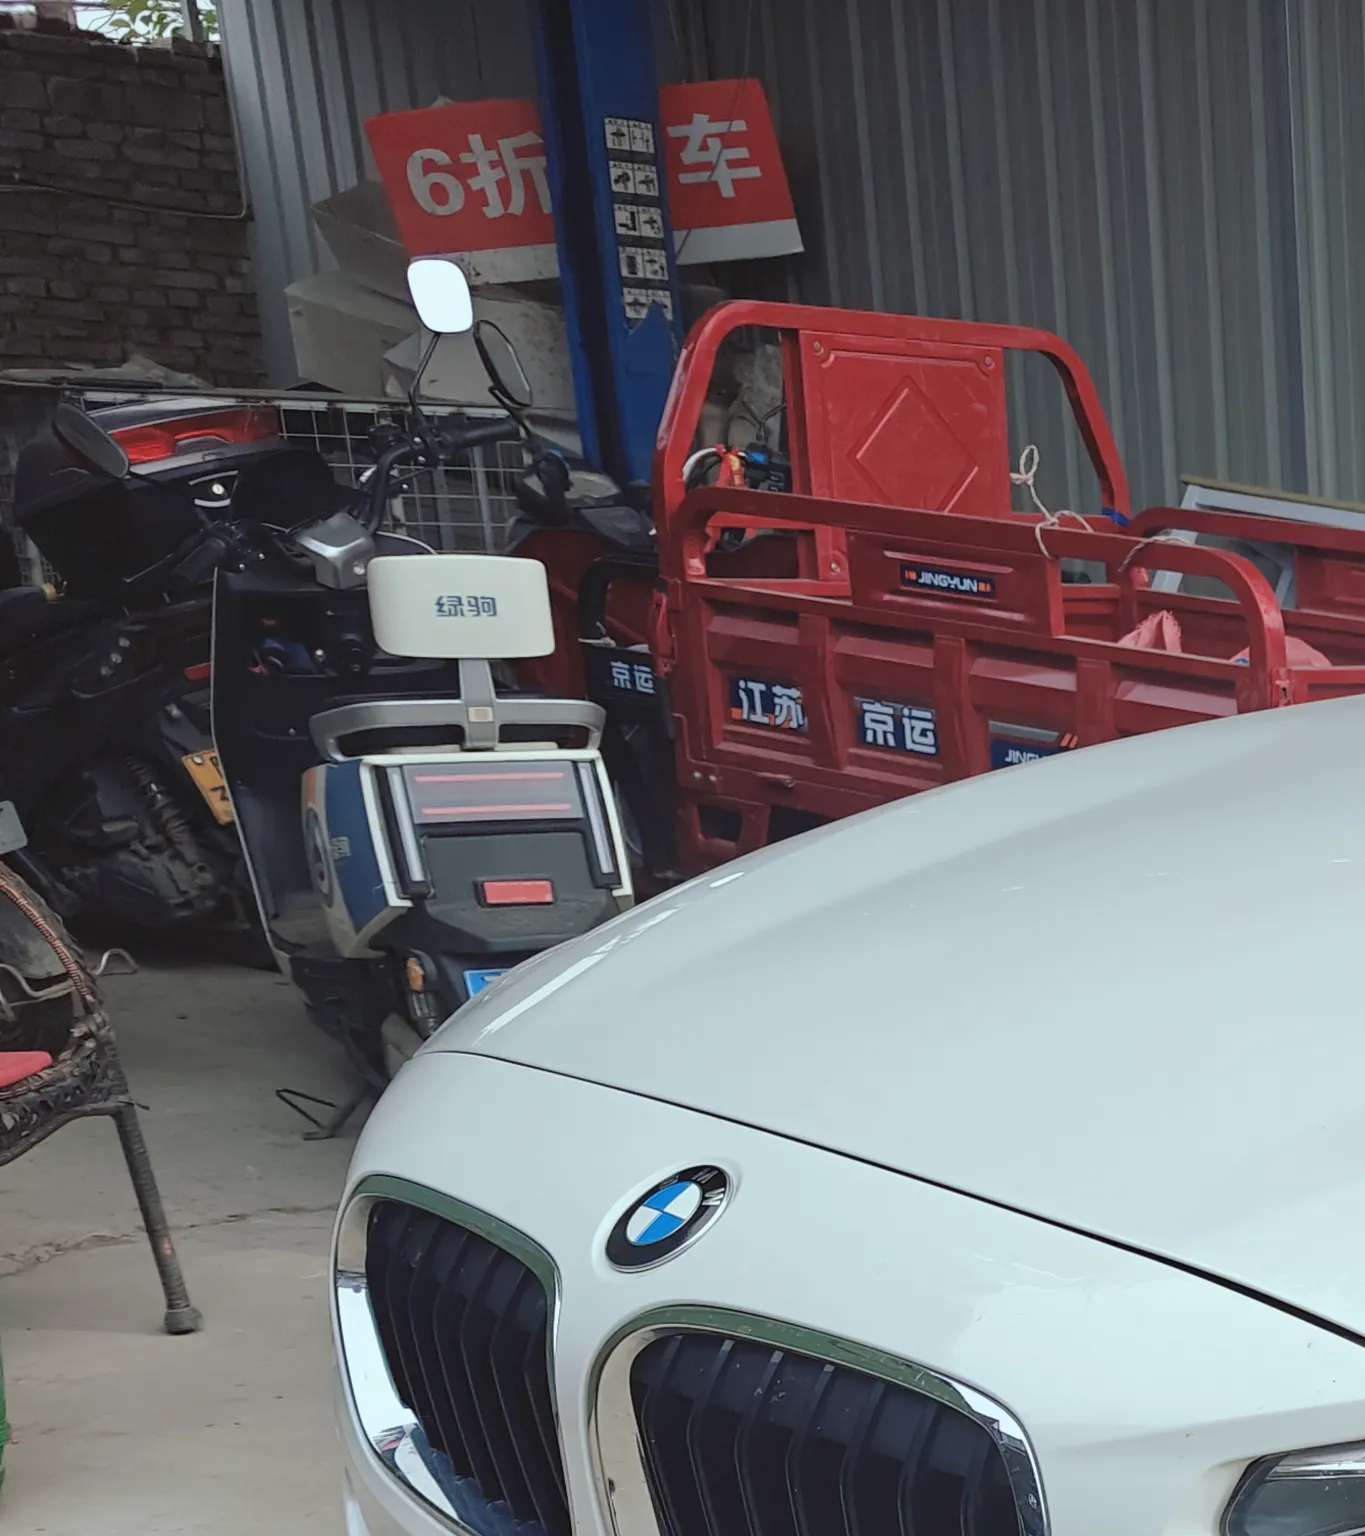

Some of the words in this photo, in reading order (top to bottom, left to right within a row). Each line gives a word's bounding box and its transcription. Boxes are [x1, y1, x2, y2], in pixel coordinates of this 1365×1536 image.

[666, 113, 761, 198] 车
[918, 571, 978, 593] JINGYUN
[435, 595, 498, 617] 绿驹
[610, 661, 656, 694] 京运
[738, 679, 808, 729] 江苏
[863, 699, 936, 755] 京运
